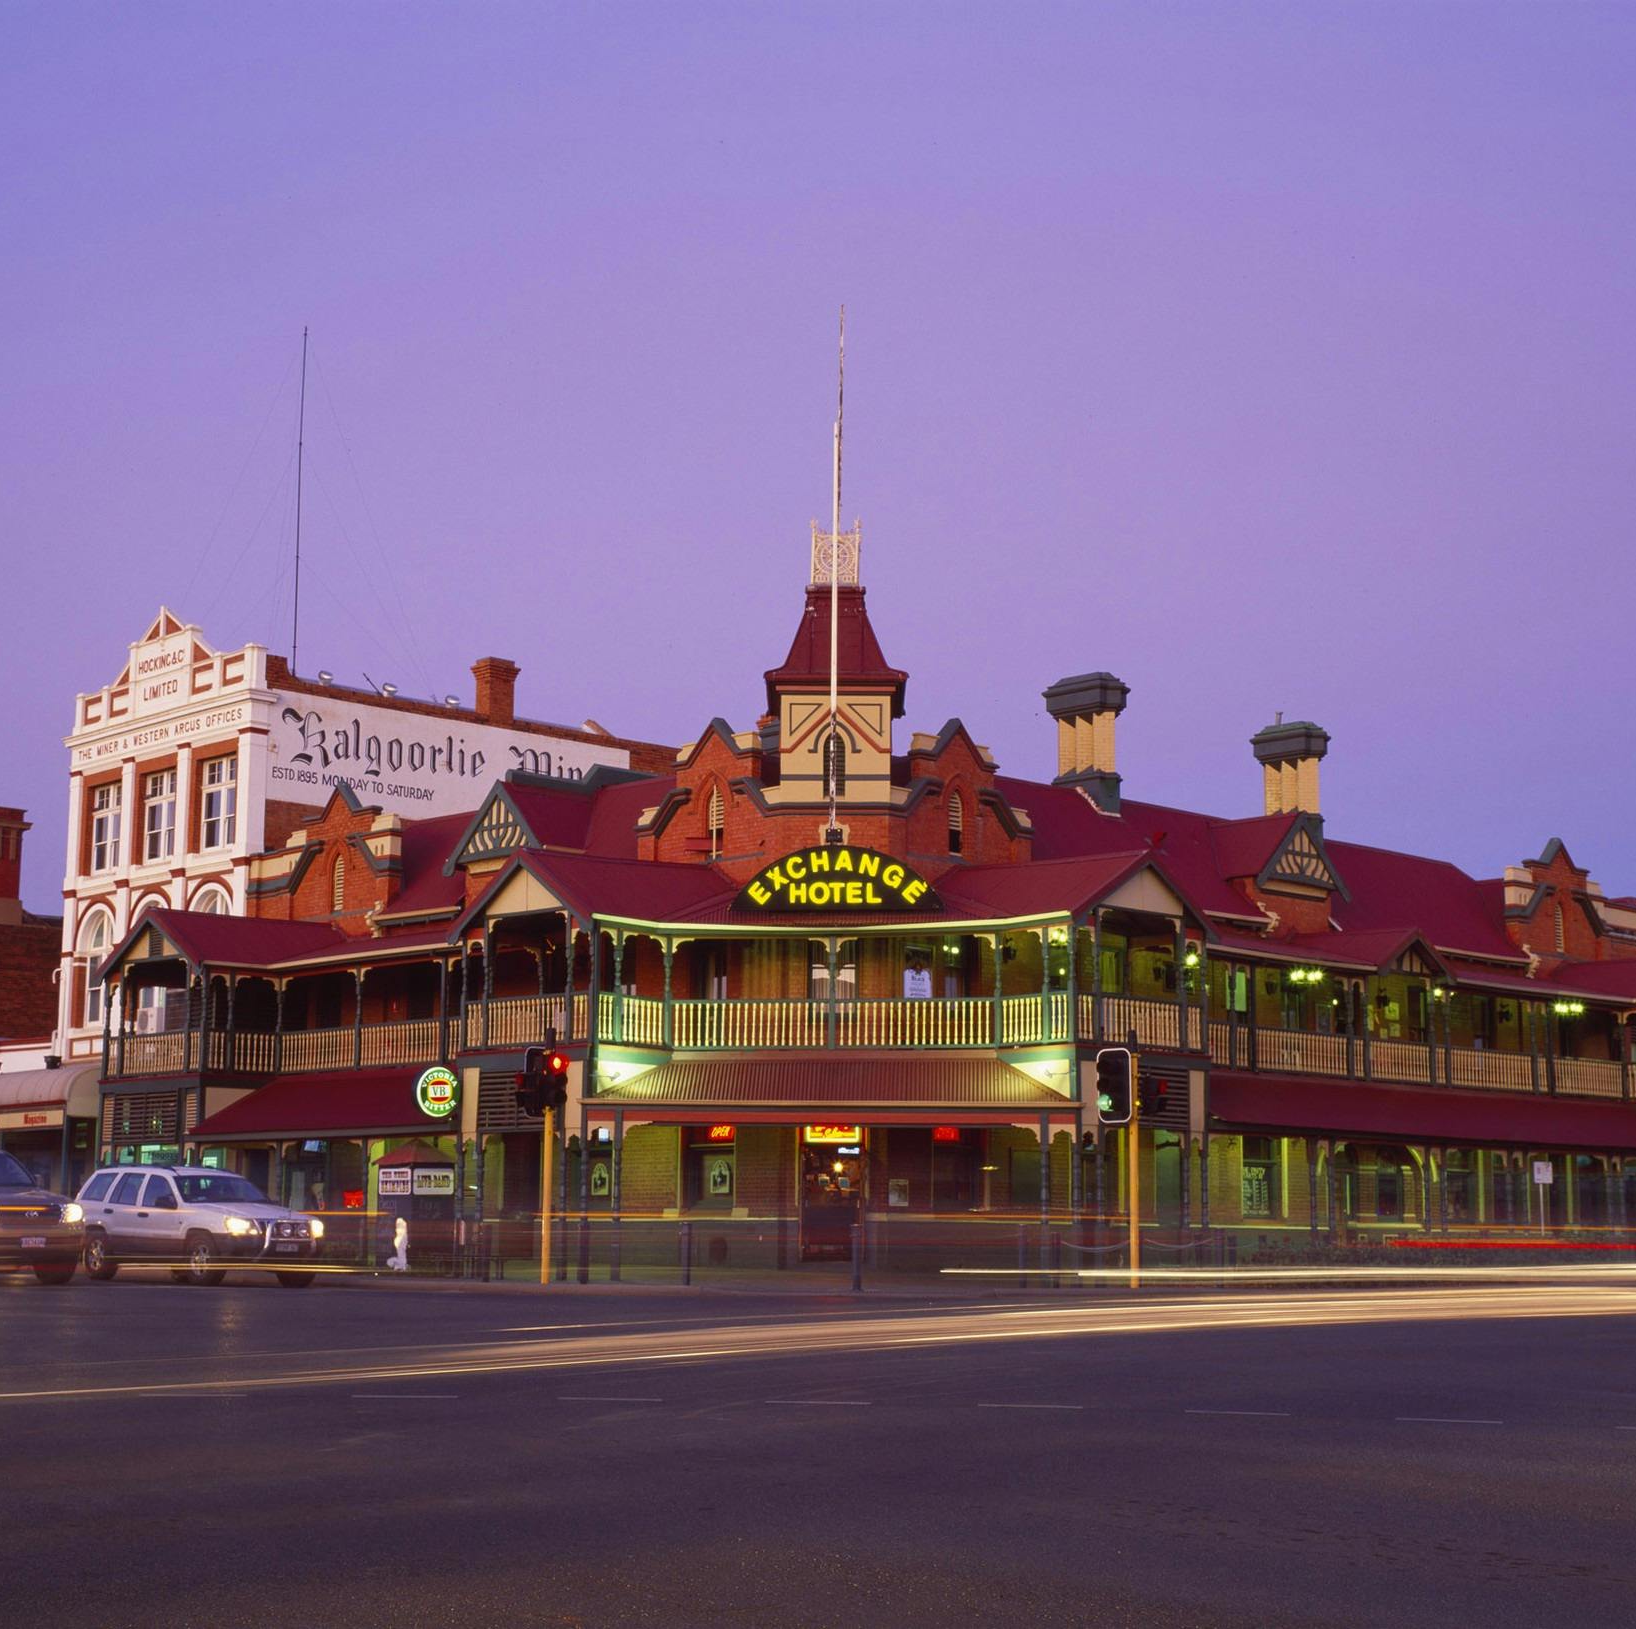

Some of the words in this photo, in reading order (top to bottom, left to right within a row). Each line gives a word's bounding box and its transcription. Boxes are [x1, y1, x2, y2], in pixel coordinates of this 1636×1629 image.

[144, 680, 178, 701] LIMITED
[79, 748, 92, 761] THE
[97, 741, 119, 756] MINER
[123, 739, 128, 749] &
[133, 728, 169, 747] WESTERN
[174, 719, 201, 736] ARGUS
[205, 707, 243, 728] OFFICES
[282, 706, 485, 778] Kalgoorlie
[321, 773, 369, 794] MONDAY
[372, 781, 384, 794] TO
[386, 783, 435, 801] SATURDAY
[747, 850, 928, 905] EXCHANGE
[789, 882, 882, 905] HOTEL
[421, 1071, 458, 1088] VICTORIA
[432, 1086, 446, 1096] VB
[424, 1100, 457, 1112] BITTER
[711, 1125, 731, 1138] OPEN
